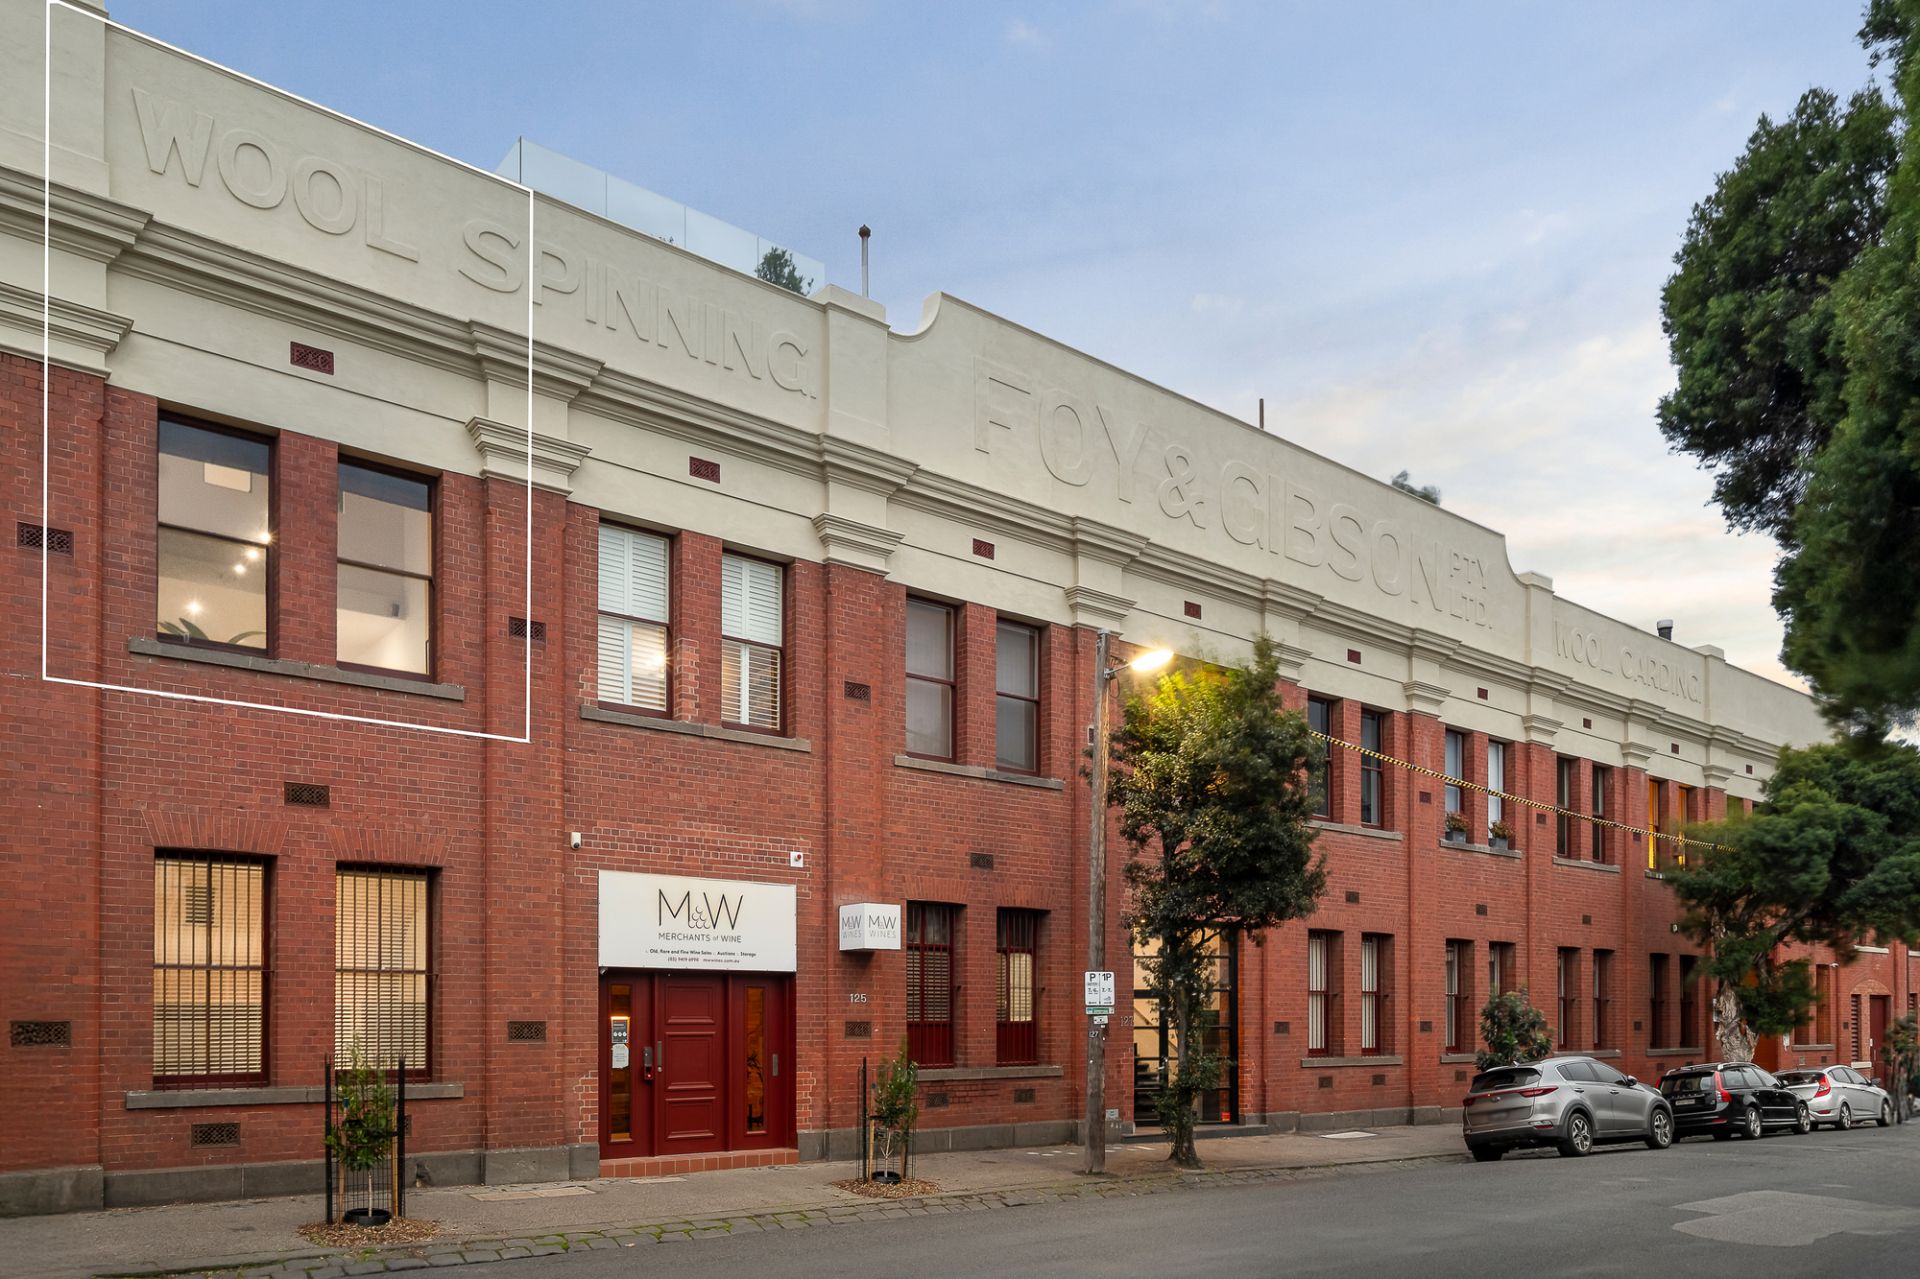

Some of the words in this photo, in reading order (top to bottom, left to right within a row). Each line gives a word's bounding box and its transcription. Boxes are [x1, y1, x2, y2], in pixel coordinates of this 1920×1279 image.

[131, 87, 418, 263] WOOL
[973, 355, 1150, 504] FOY
[1158, 445, 1206, 529] &
[1220, 460, 1444, 612] GIBSON
[1450, 550, 1489, 589] PTY
[1553, 614, 1613, 675] WOOL
[658, 931, 711, 942] MERCHANTS
[720, 935, 742, 943] WINE
[869, 929, 897, 939] WINES
[1089, 973, 1096, 981] P
[1102, 973, 1111, 981] 1P
[849, 993, 867, 1003] 125
